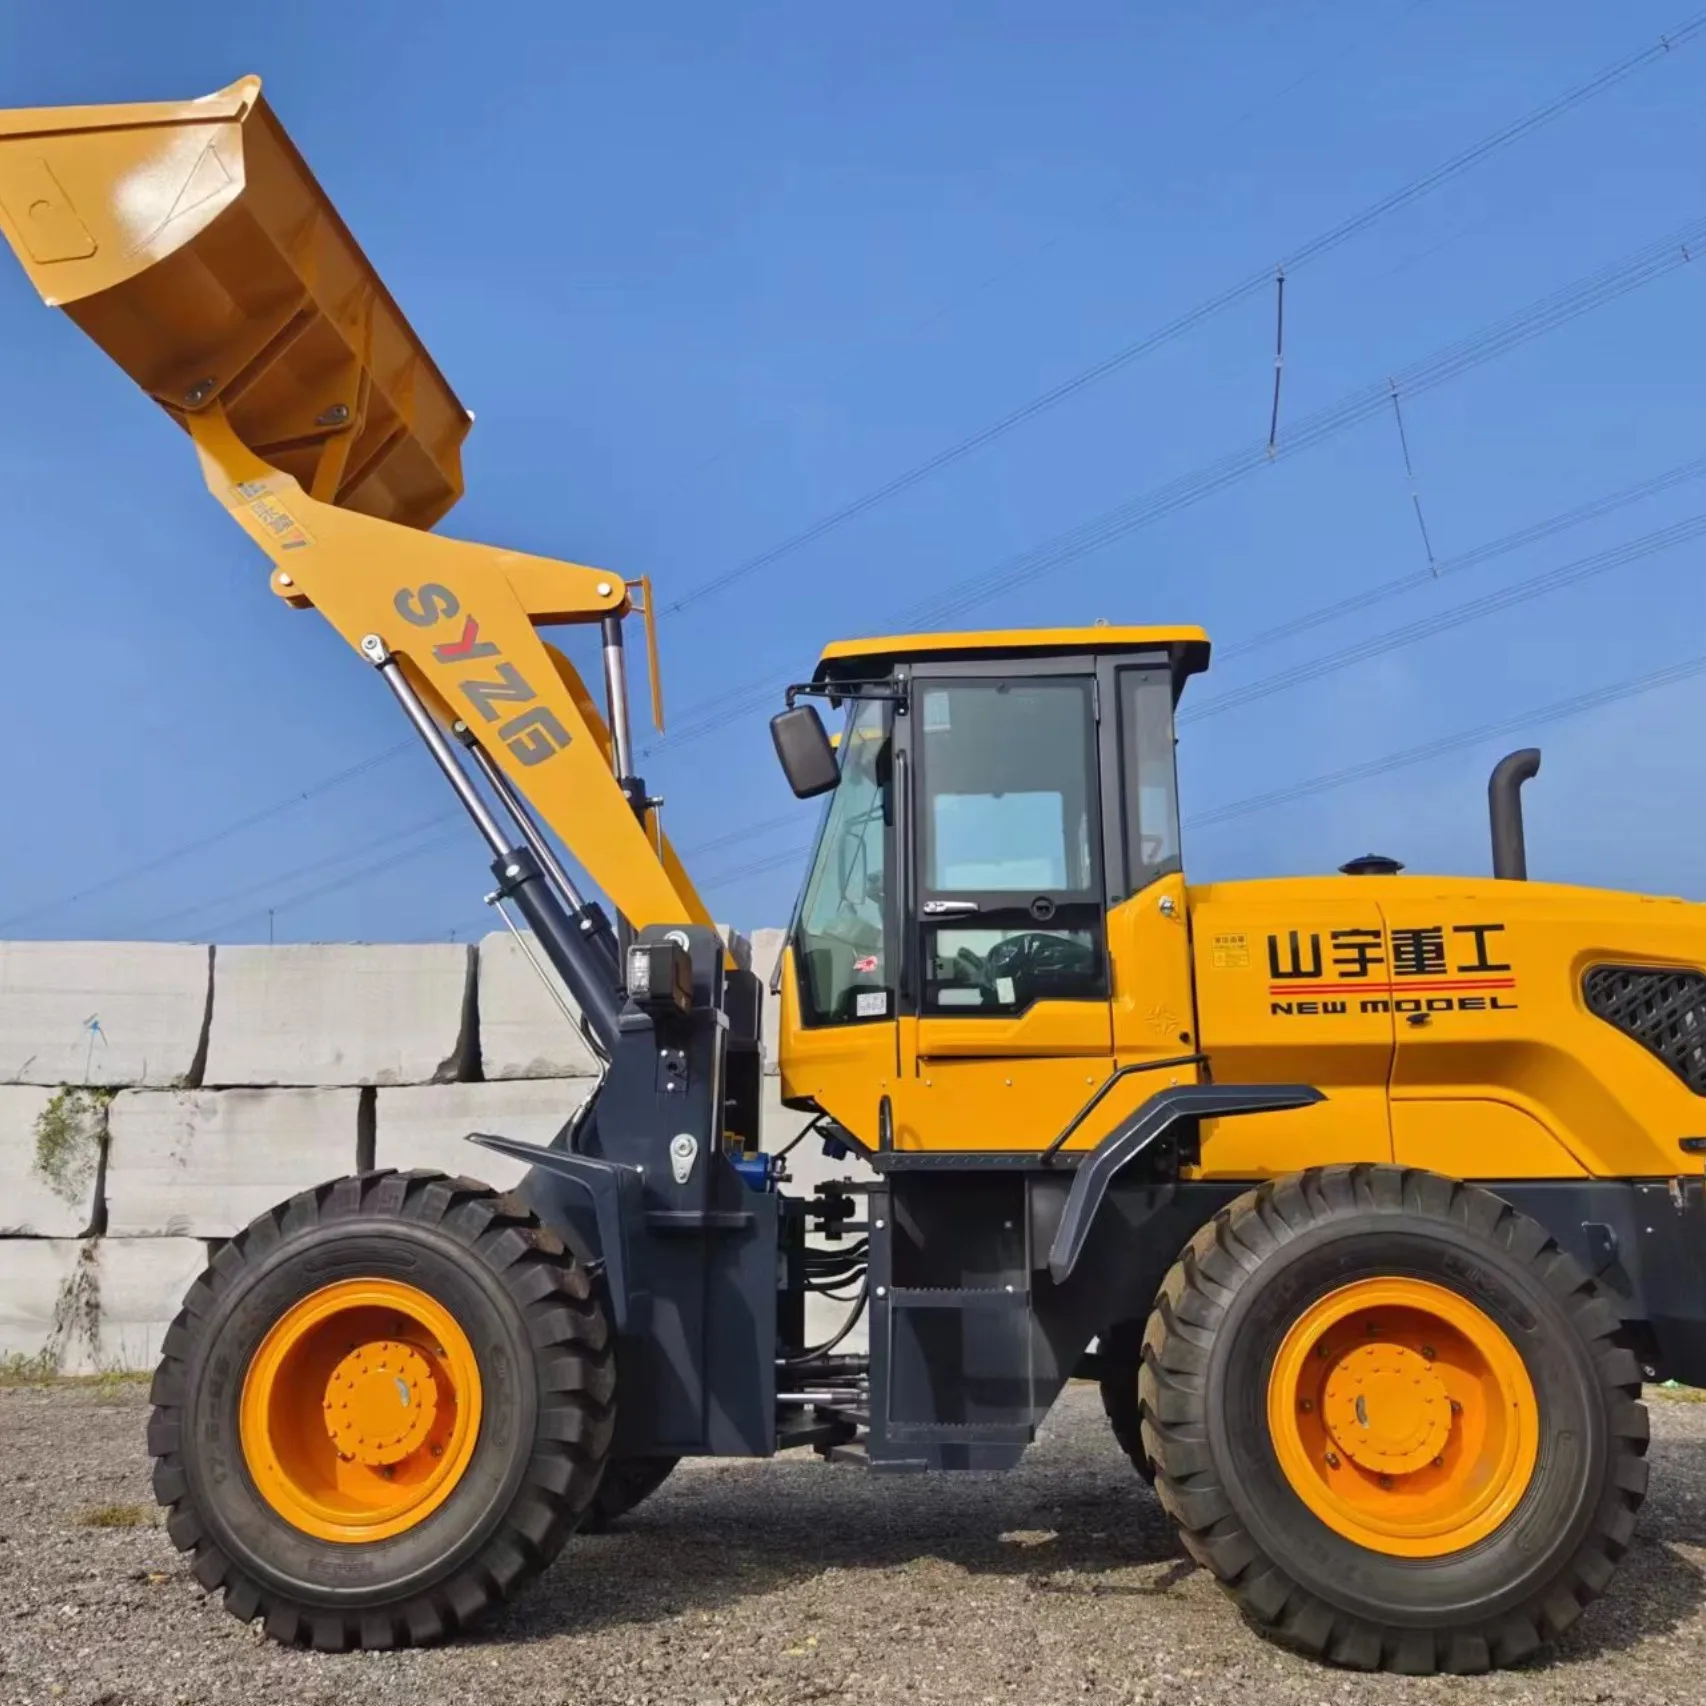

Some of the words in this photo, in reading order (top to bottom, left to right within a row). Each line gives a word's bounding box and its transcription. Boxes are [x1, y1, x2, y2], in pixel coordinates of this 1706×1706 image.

[394, 583, 572, 766] SYZG
[1267, 924, 1511, 978] 山宇重工
[1270, 1001, 1347, 1015] NEW
[1360, 997, 1518, 1013] MODEL
